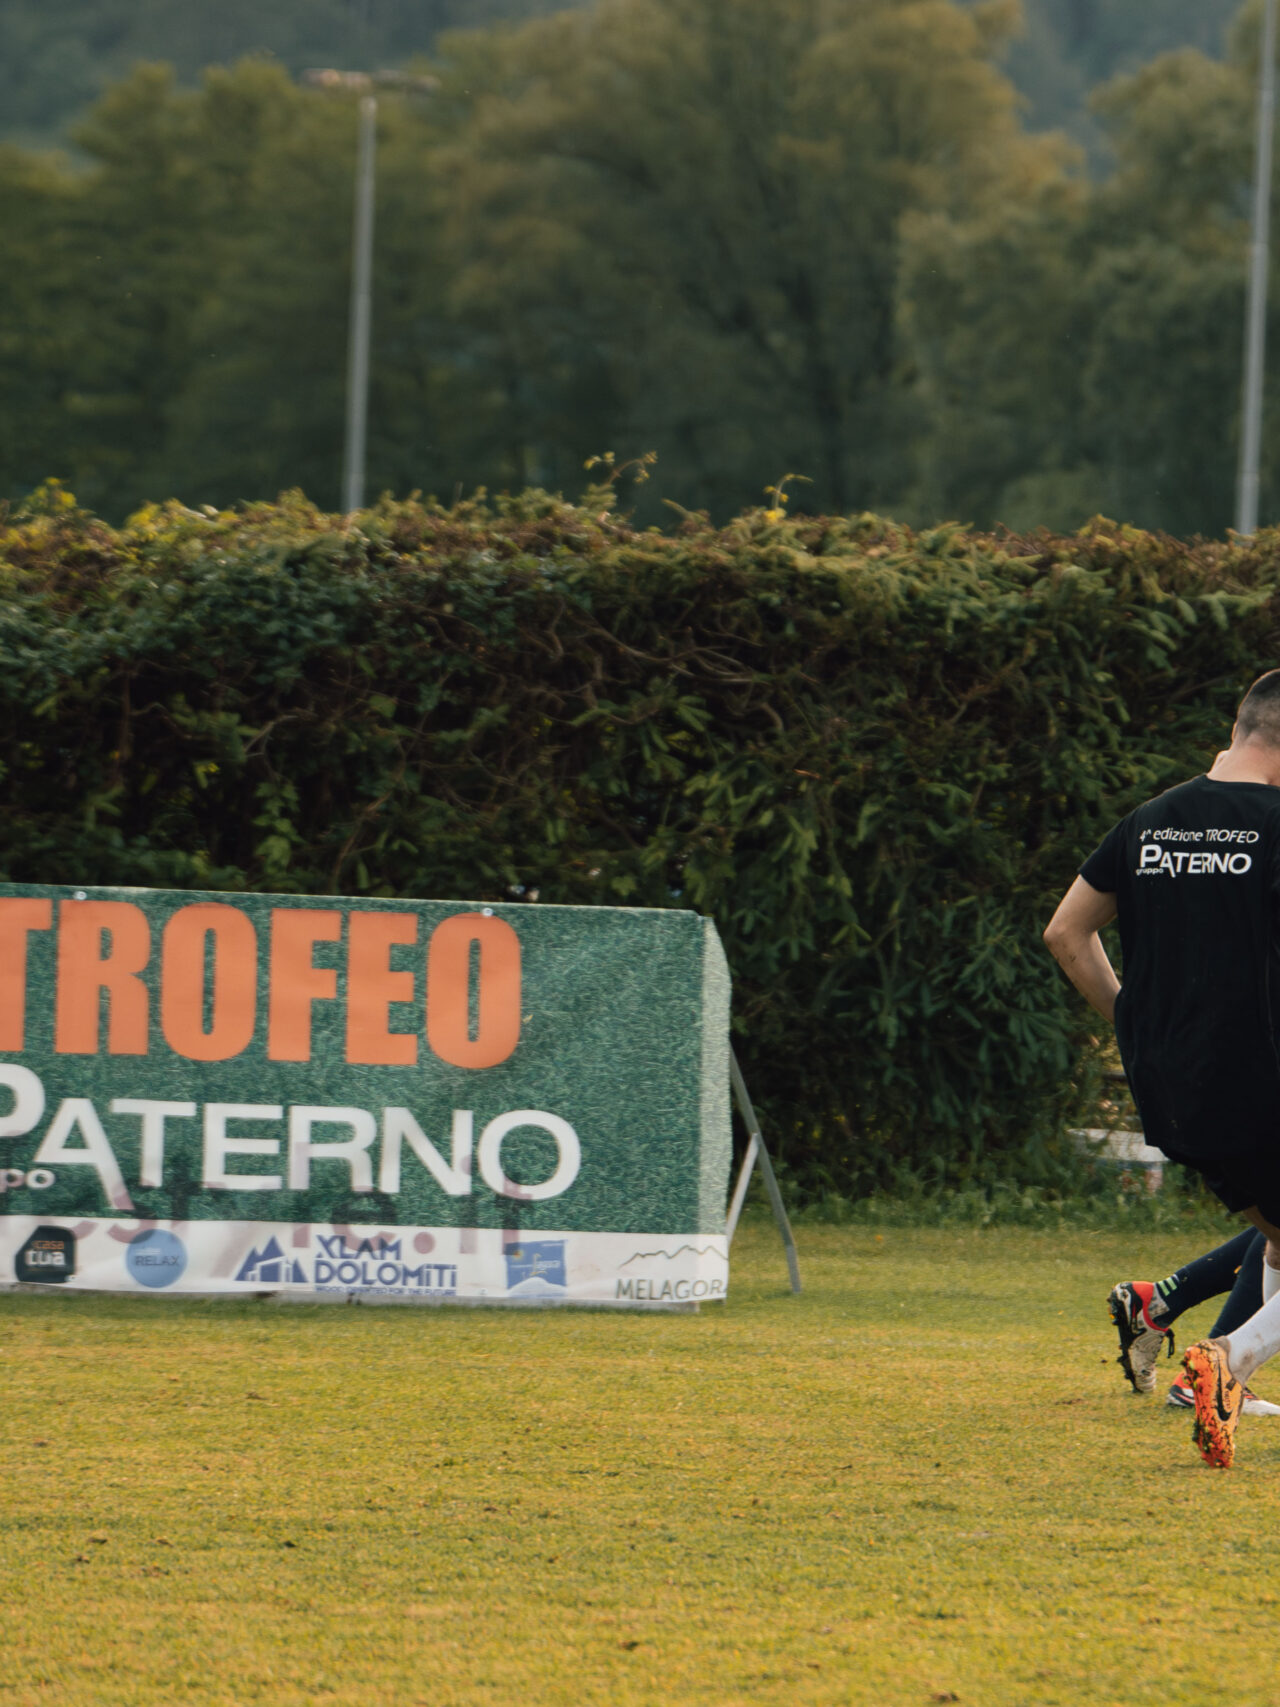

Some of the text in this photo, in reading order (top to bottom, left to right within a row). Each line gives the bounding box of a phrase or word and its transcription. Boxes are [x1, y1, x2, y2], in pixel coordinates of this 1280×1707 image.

[1153, 827, 1204, 842] edizione
[1206, 829, 1260, 843] TROFEO
[1140, 844, 1252, 878] PATERNO
[1135, 867, 1164, 876] gruppo
[314, 1234, 403, 1260] XLAM
[25, 1250, 66, 1267] tua
[135, 1255, 180, 1267] RELAX
[616, 1278, 727, 1301] MELAGOR
